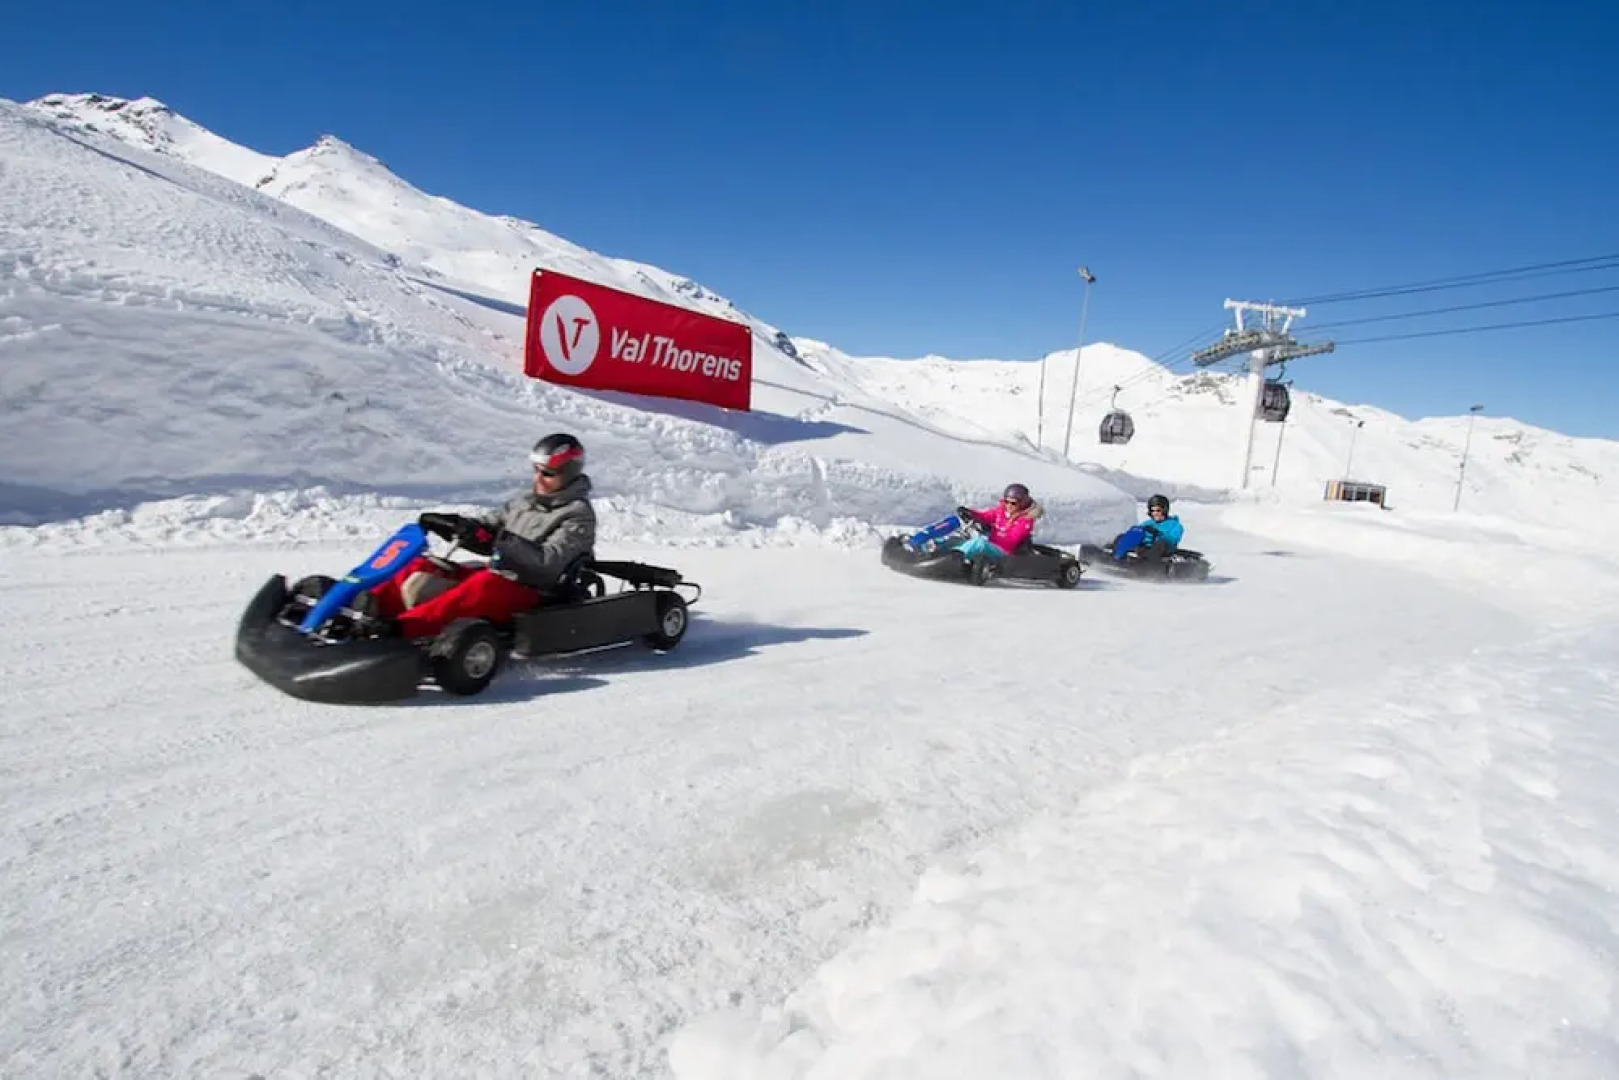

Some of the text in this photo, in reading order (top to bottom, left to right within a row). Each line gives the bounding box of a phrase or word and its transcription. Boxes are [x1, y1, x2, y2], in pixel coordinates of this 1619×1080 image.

[610, 326, 742, 382] Val Thorens
[370, 539, 410, 569] 5
